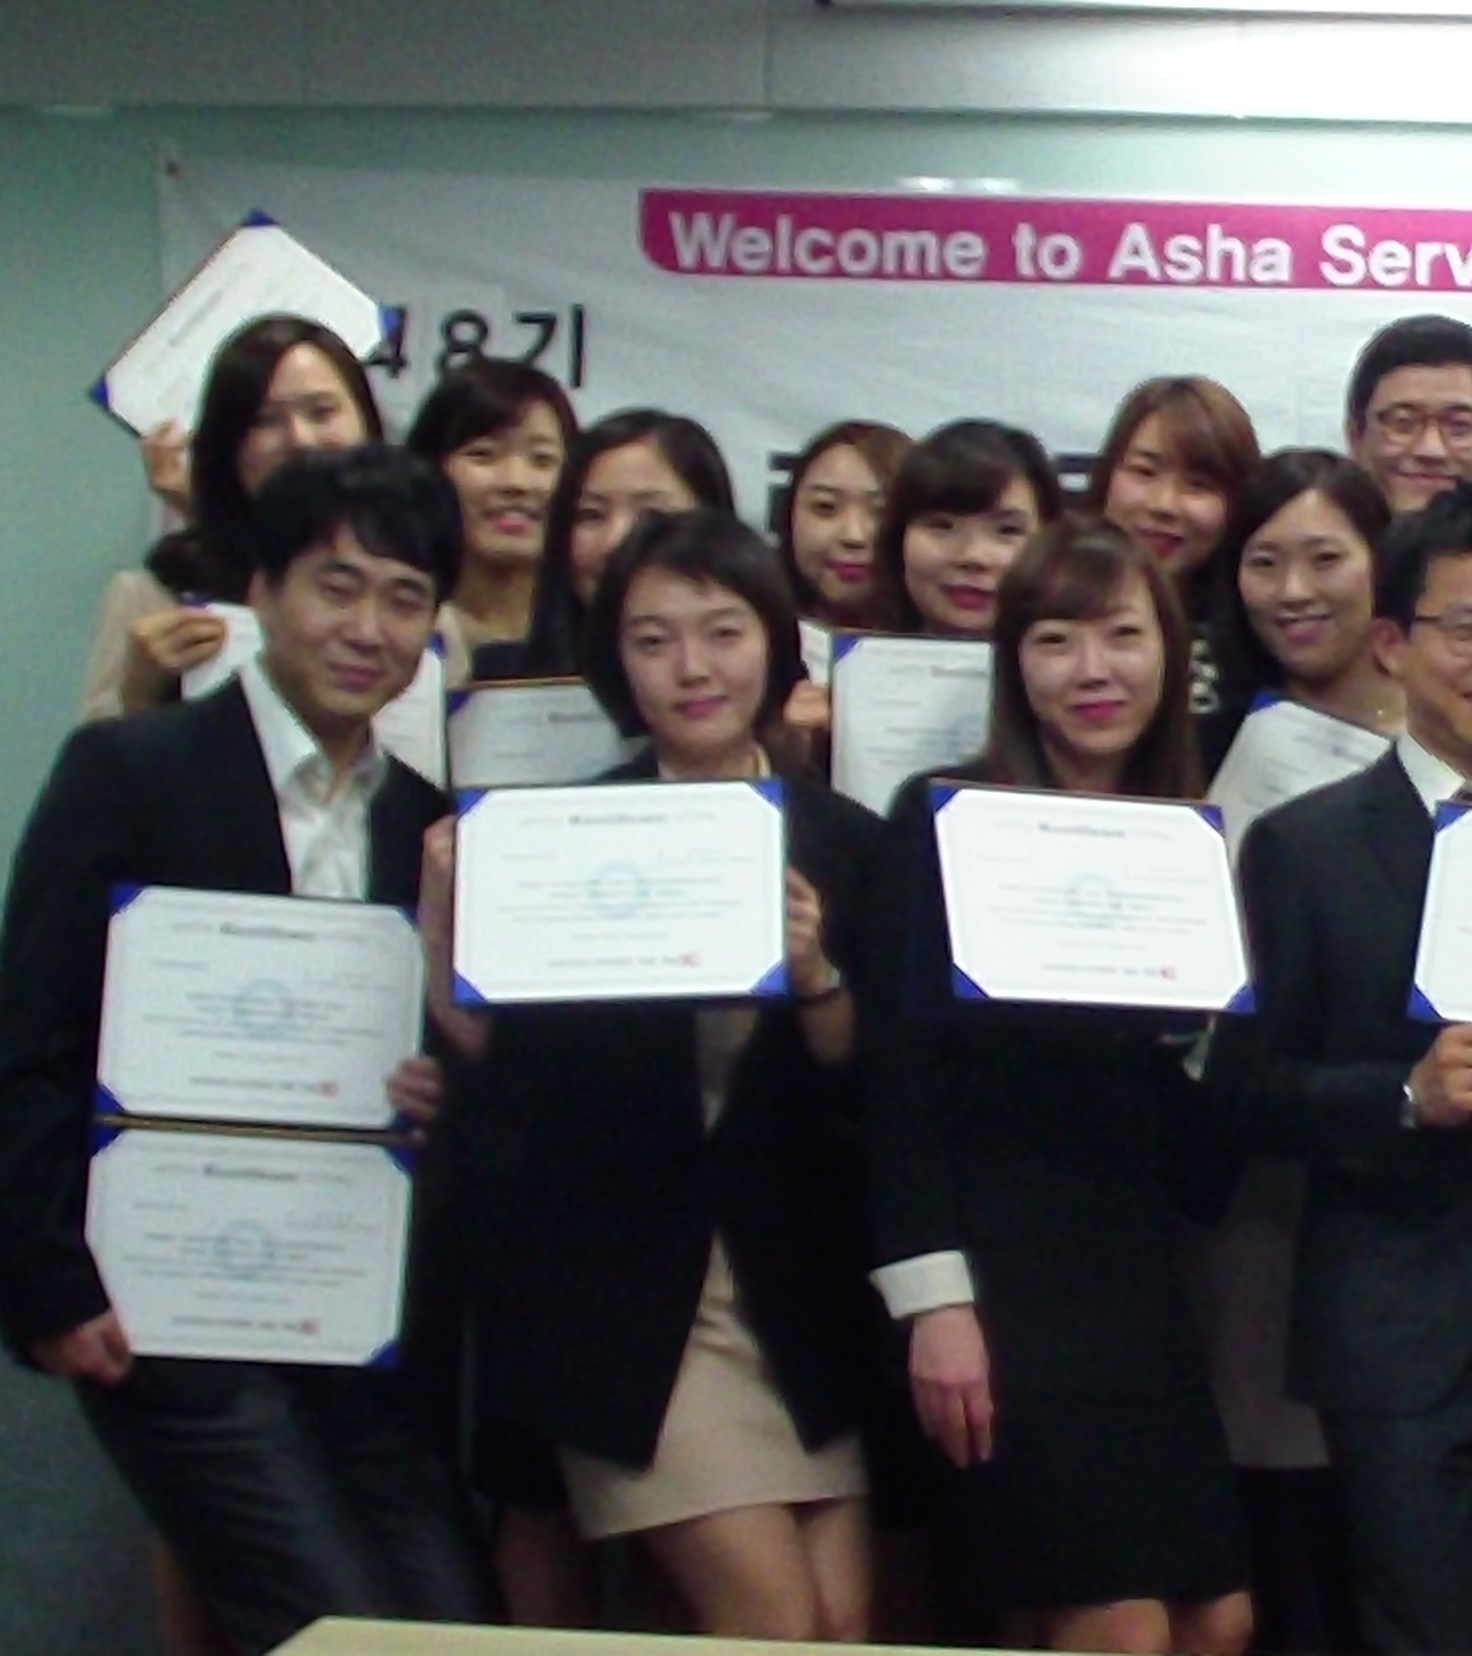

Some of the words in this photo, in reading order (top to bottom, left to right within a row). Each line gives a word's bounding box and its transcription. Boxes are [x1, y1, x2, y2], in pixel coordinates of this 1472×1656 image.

[669, 211, 988, 277] Welcome
[1012, 223, 1083, 279] to
[1108, 222, 1294, 283] Asha
